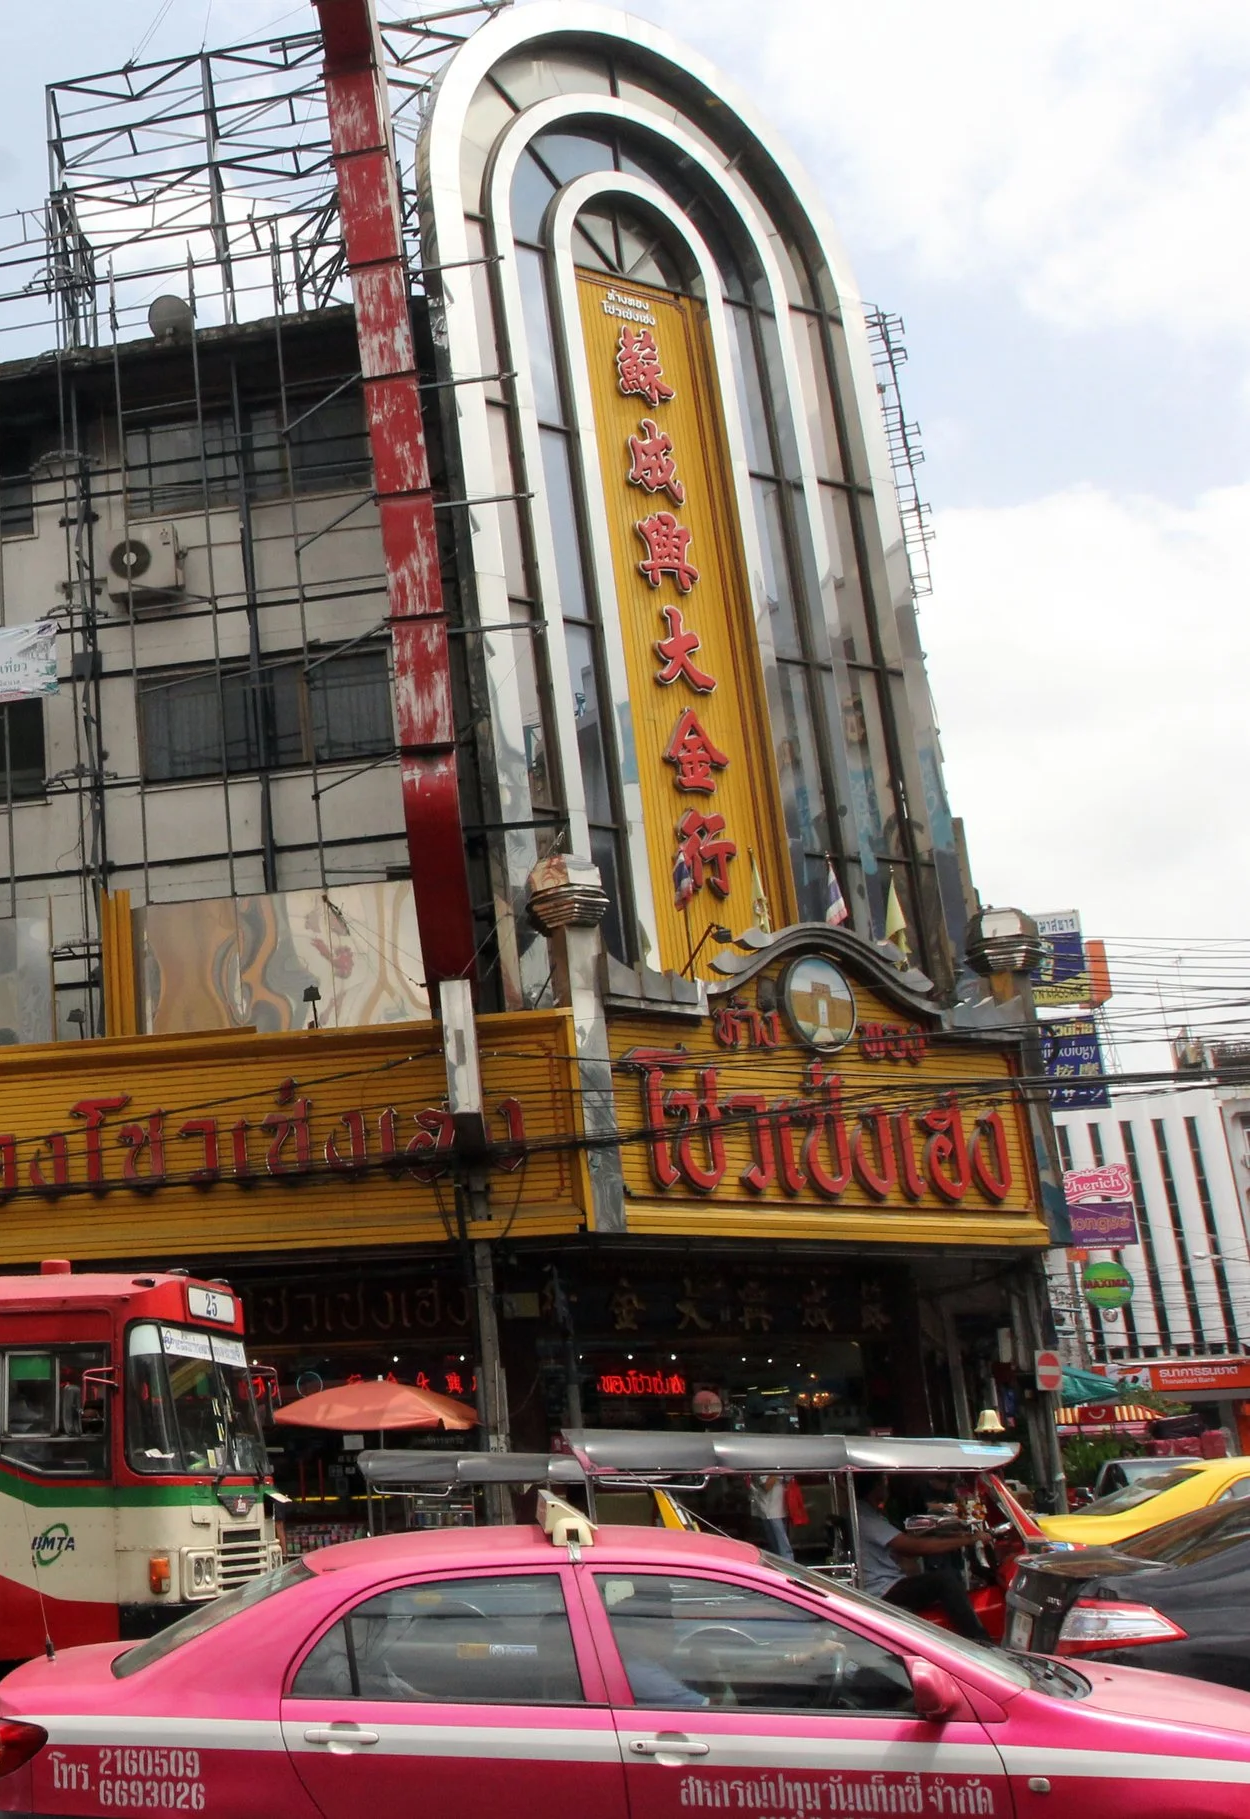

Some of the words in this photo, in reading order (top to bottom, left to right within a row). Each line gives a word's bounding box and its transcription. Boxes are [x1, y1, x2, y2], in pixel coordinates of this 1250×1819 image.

[616, 325, 738, 900] 蘇成興大金行
[205, 1293, 217, 1317] 25
[99, 1749, 200, 1778] 2160509
[100, 1780, 205, 1810] 6693026
[928, 1776, 994, 1815] จำกัด
